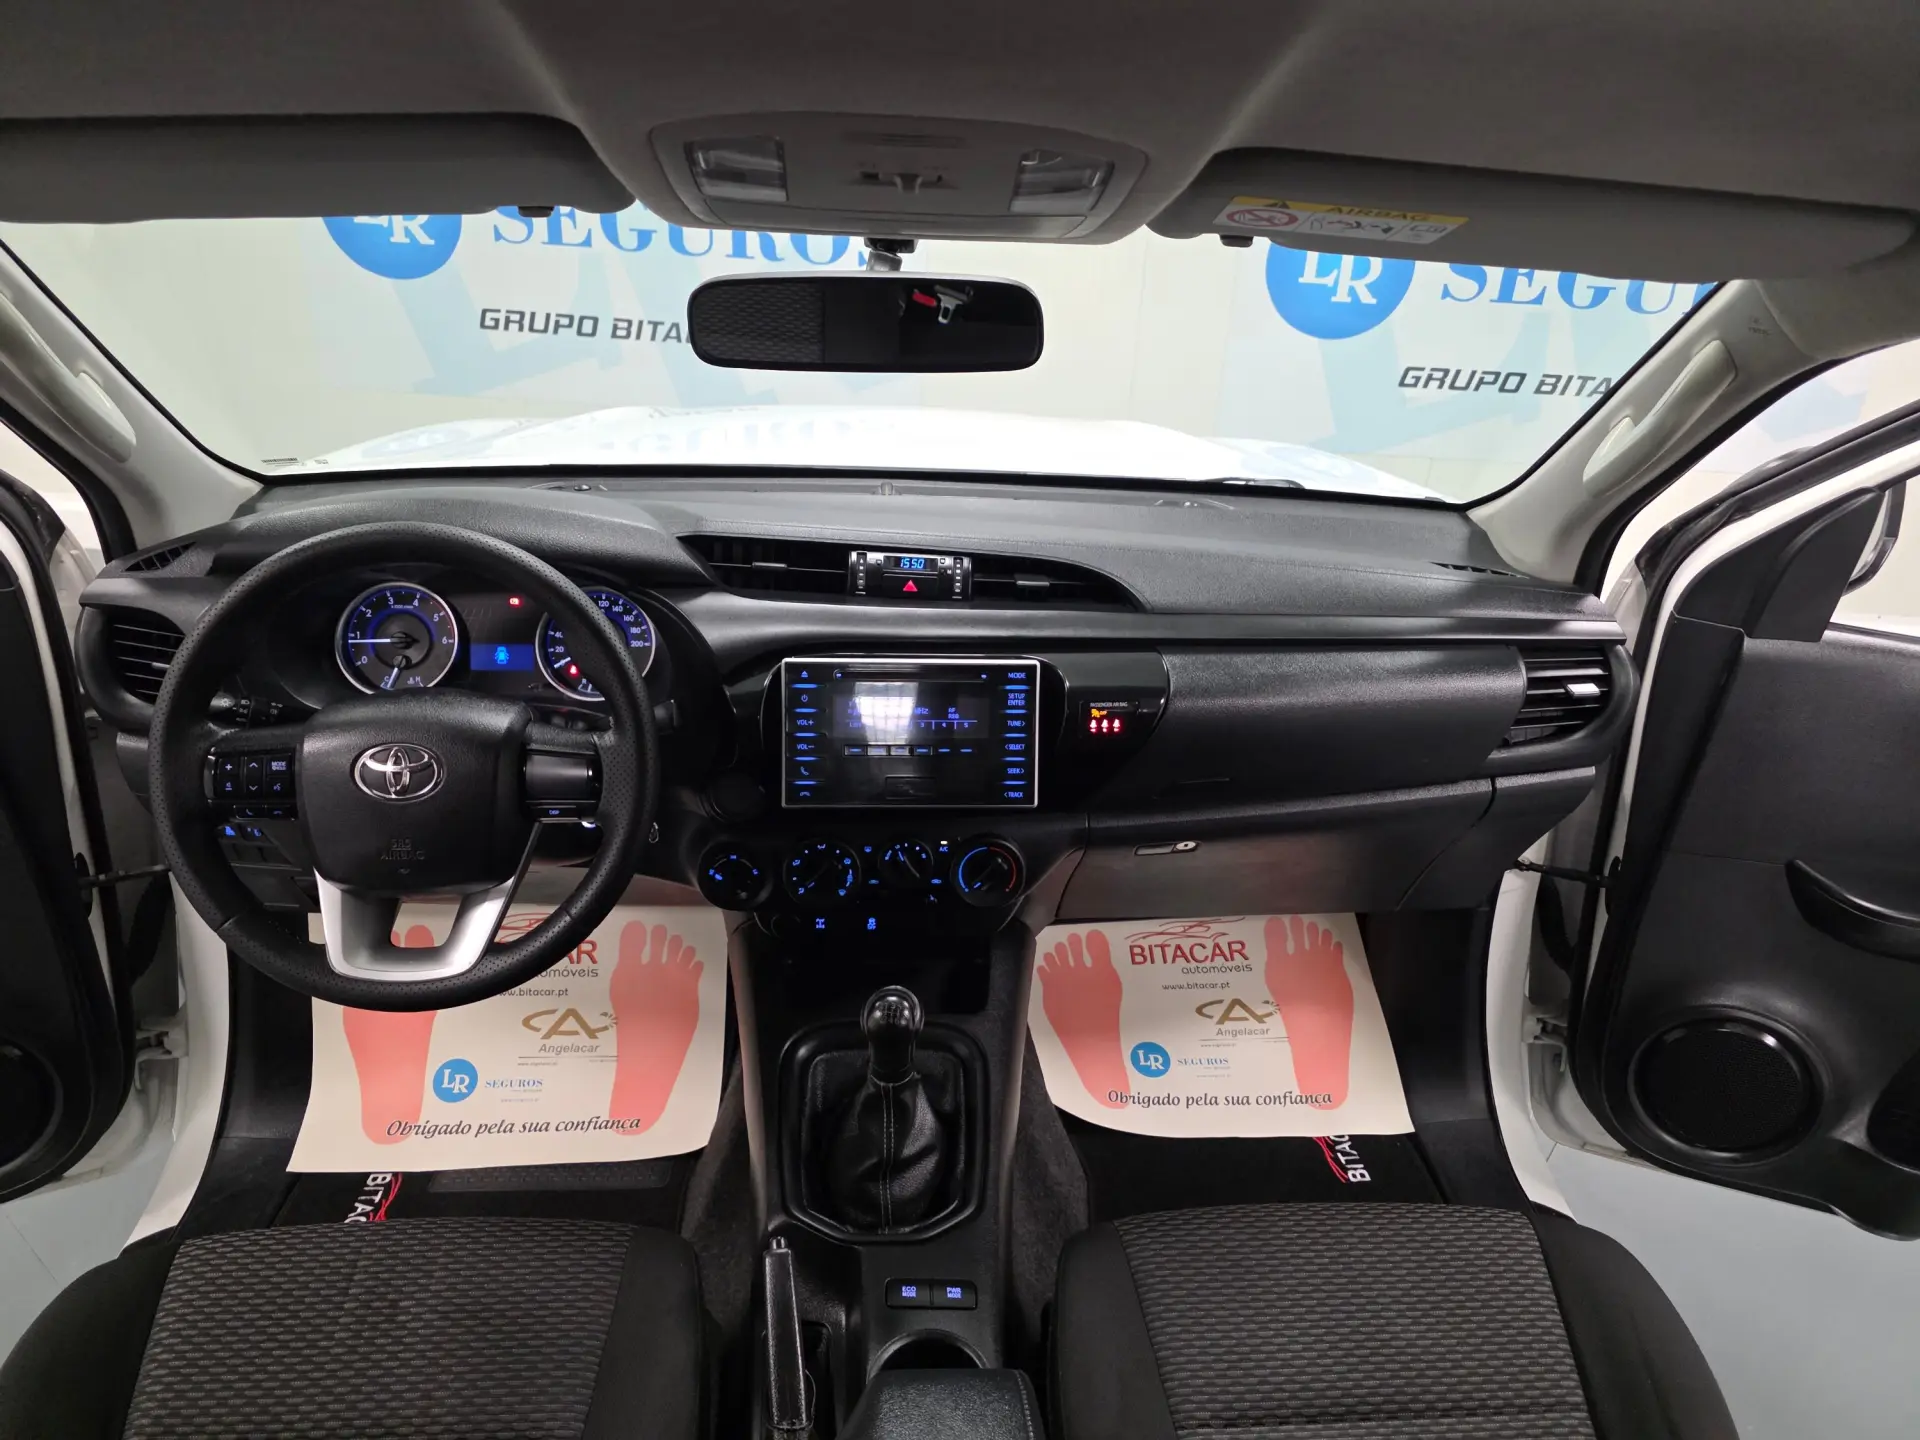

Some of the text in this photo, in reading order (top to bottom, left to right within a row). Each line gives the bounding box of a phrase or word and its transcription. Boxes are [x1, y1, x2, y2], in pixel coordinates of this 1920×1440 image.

[493, 205, 868, 267] SEGURO
[1298, 250, 1383, 304] LR
[480, 308, 690, 344] GRUPO BITA
[1398, 366, 1527, 394] GRUPO
[388, 597, 394, 605] 3
[413, 599, 419, 607] 4
[365, 609, 372, 618] 2
[433, 613, 439, 622] 5
[356, 631, 360, 639] 1
[442, 636, 448, 644] 6
[631, 640, 643, 648] 200
[361, 655, 368, 664] 0
[1129, 940, 1249, 965] BITACAR
[1181, 962, 1252, 975] automóveis
[1162, 981, 1230, 991] www.bitacar.pt
[1215, 1027, 1271, 1038] Angelacar
[538, 1043, 601, 1055] Angelacar
[1137, 1049, 1229, 1070] LR SEGUROS
[441, 1068, 544, 1094] LR SEGUROS
[1108, 1090, 1333, 1109] Obrigado pela sua confiança
[386, 1114, 641, 1139] Obrigado pela sua confiança
